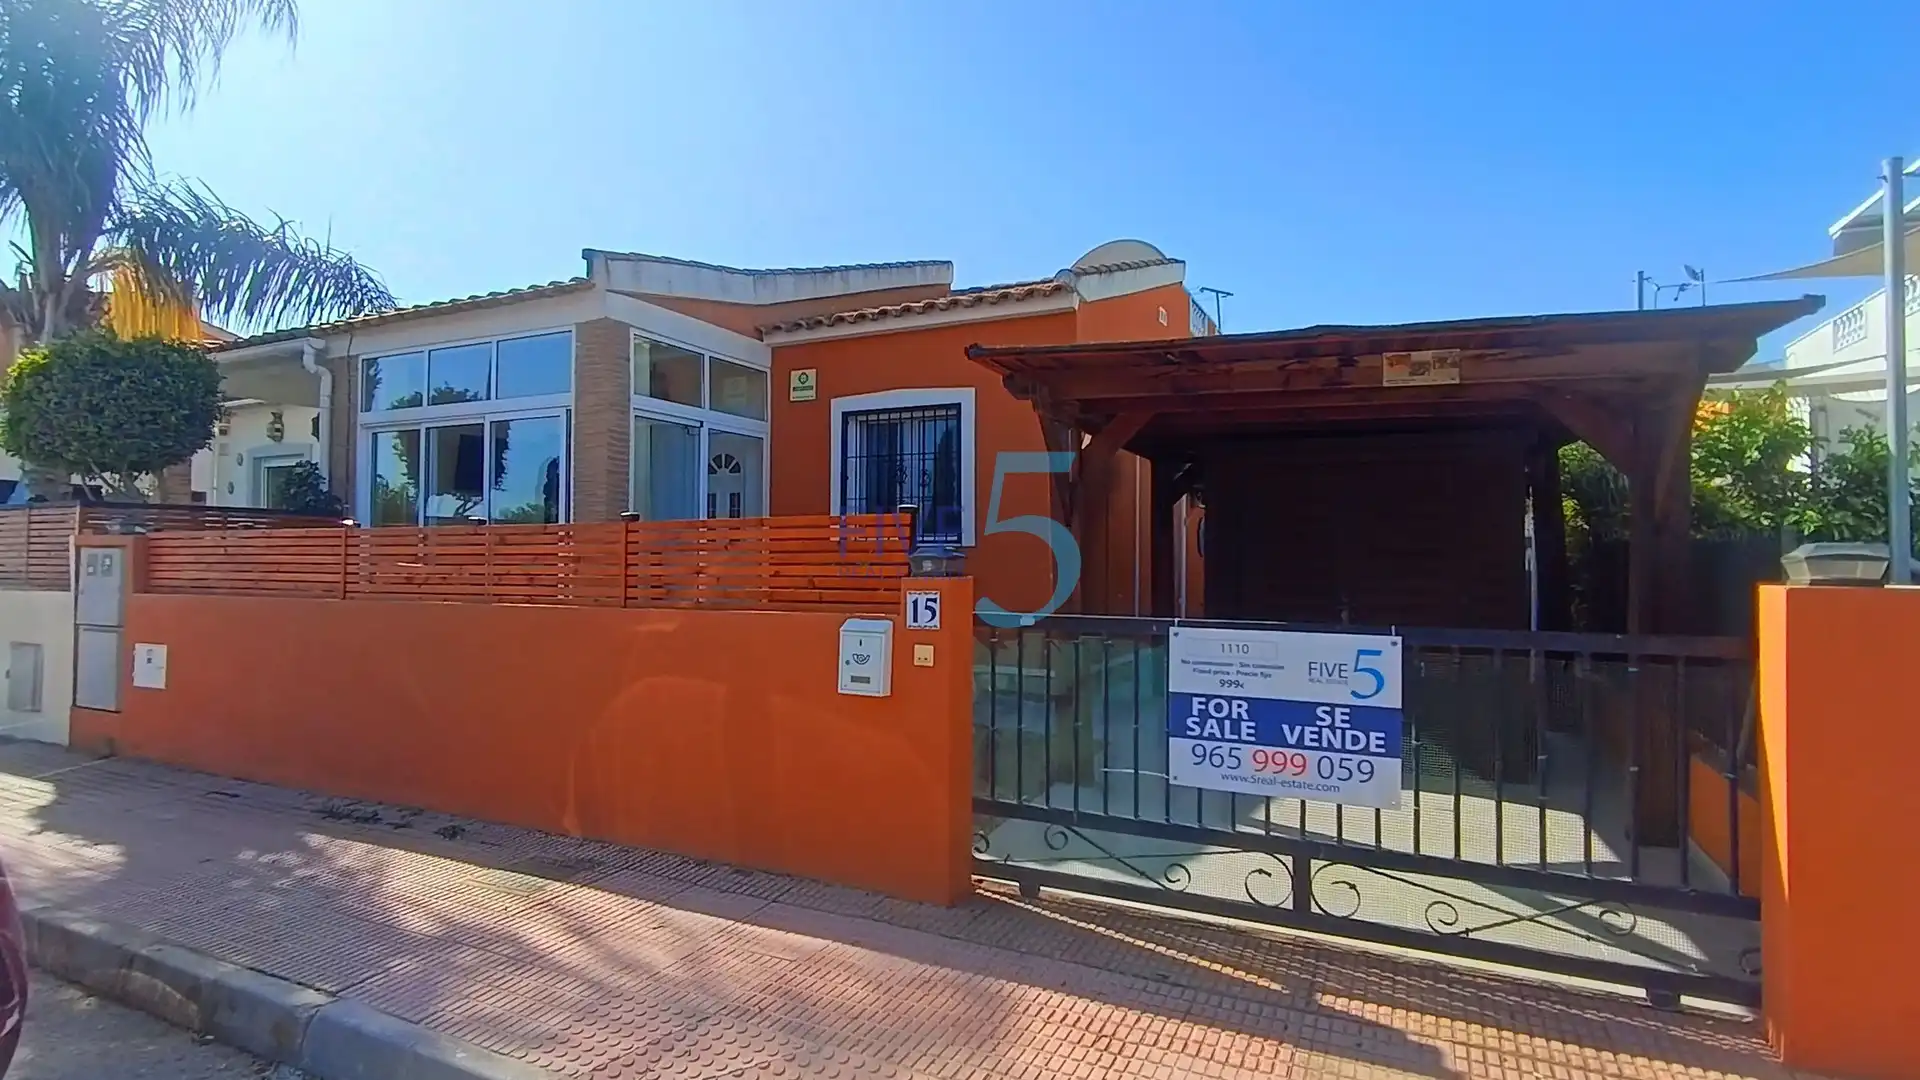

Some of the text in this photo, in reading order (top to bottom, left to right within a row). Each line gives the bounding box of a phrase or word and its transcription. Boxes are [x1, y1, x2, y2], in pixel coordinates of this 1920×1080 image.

[911, 597, 938, 624] 15
[1221, 643, 1250, 654] 1110
[1308, 648, 1385, 699] FIVE 5
[1191, 696, 1249, 720] FOR
[1315, 706, 1351, 728] SE
[1186, 716, 1256, 742] SALE
[1281, 724, 1386, 753] VENDE
[1191, 743, 1375, 783] 965 999 059
